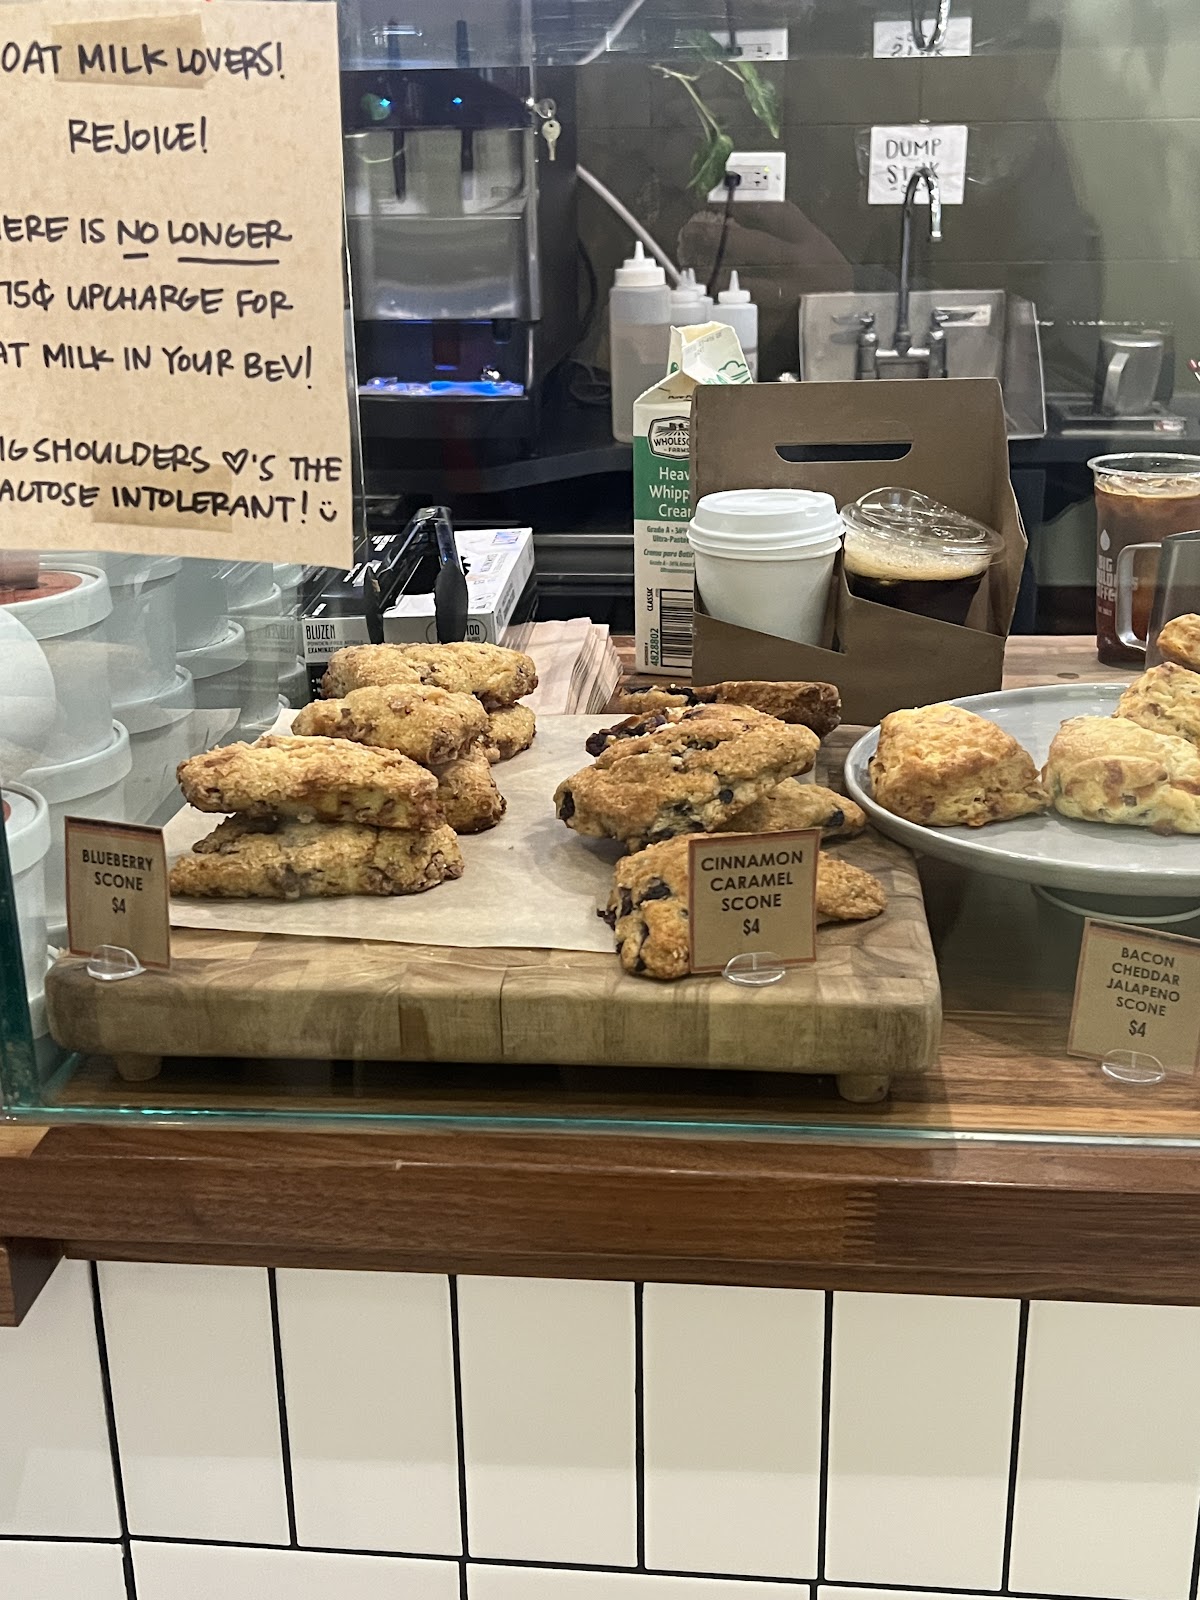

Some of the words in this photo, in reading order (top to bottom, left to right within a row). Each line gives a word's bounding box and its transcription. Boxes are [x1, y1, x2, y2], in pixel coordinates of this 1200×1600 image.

[1, 41, 62, 75] OAT
[78, 43, 169, 75] MILK
[176, 41, 285, 80] LOVERS!
[68, 115, 208, 154] REJOICE!
[886, 138, 941, 159] DUMP
[887, 161, 939, 184] SIK
[0, 214, 69, 243] ERE
[80, 217, 105, 244] IS
[117, 219, 159, 246] NO
[167, 219, 293, 248] LONGER
[66, 283, 224, 314] UPCHARGE
[236, 289, 294, 319] FOR
[0, 340, 30, 369] AT
[43, 342, 115, 372] MILK
[123, 345, 151, 371] IN
[161, 345, 235, 377] YOUR
[244, 345, 312, 390] BEV!
[0, 435, 28, 462] IG
[32, 437, 211, 474] SHOULDERS
[289, 456, 343, 483] THE
[659, 466, 690, 481] Heav
[0, 478, 100, 507] ACTOSE
[111, 485, 308, 524] INTOLERANT!
[649, 484, 690, 503] Whipp
[646, 587, 654, 612] CLASSIC
[305, 624, 336, 640] BLUZEN
[82, 849, 153, 872] BLUEBERRY
[701, 851, 803, 871] CINNAMON
[94, 871, 144, 891] SCONE
[710, 872, 793, 892] CARAMEL
[112, 896, 126, 914] $4
[721, 893, 782, 912] SCONE
[743, 918, 760, 936] $4
[1121, 947, 1175, 968] BACON
[1111, 962, 1180, 986] CHEDDAR
[1106, 978, 1180, 1002] JALAPENO
[1116, 996, 1167, 1016] SCONE
[1128, 1019, 1147, 1037] $4
